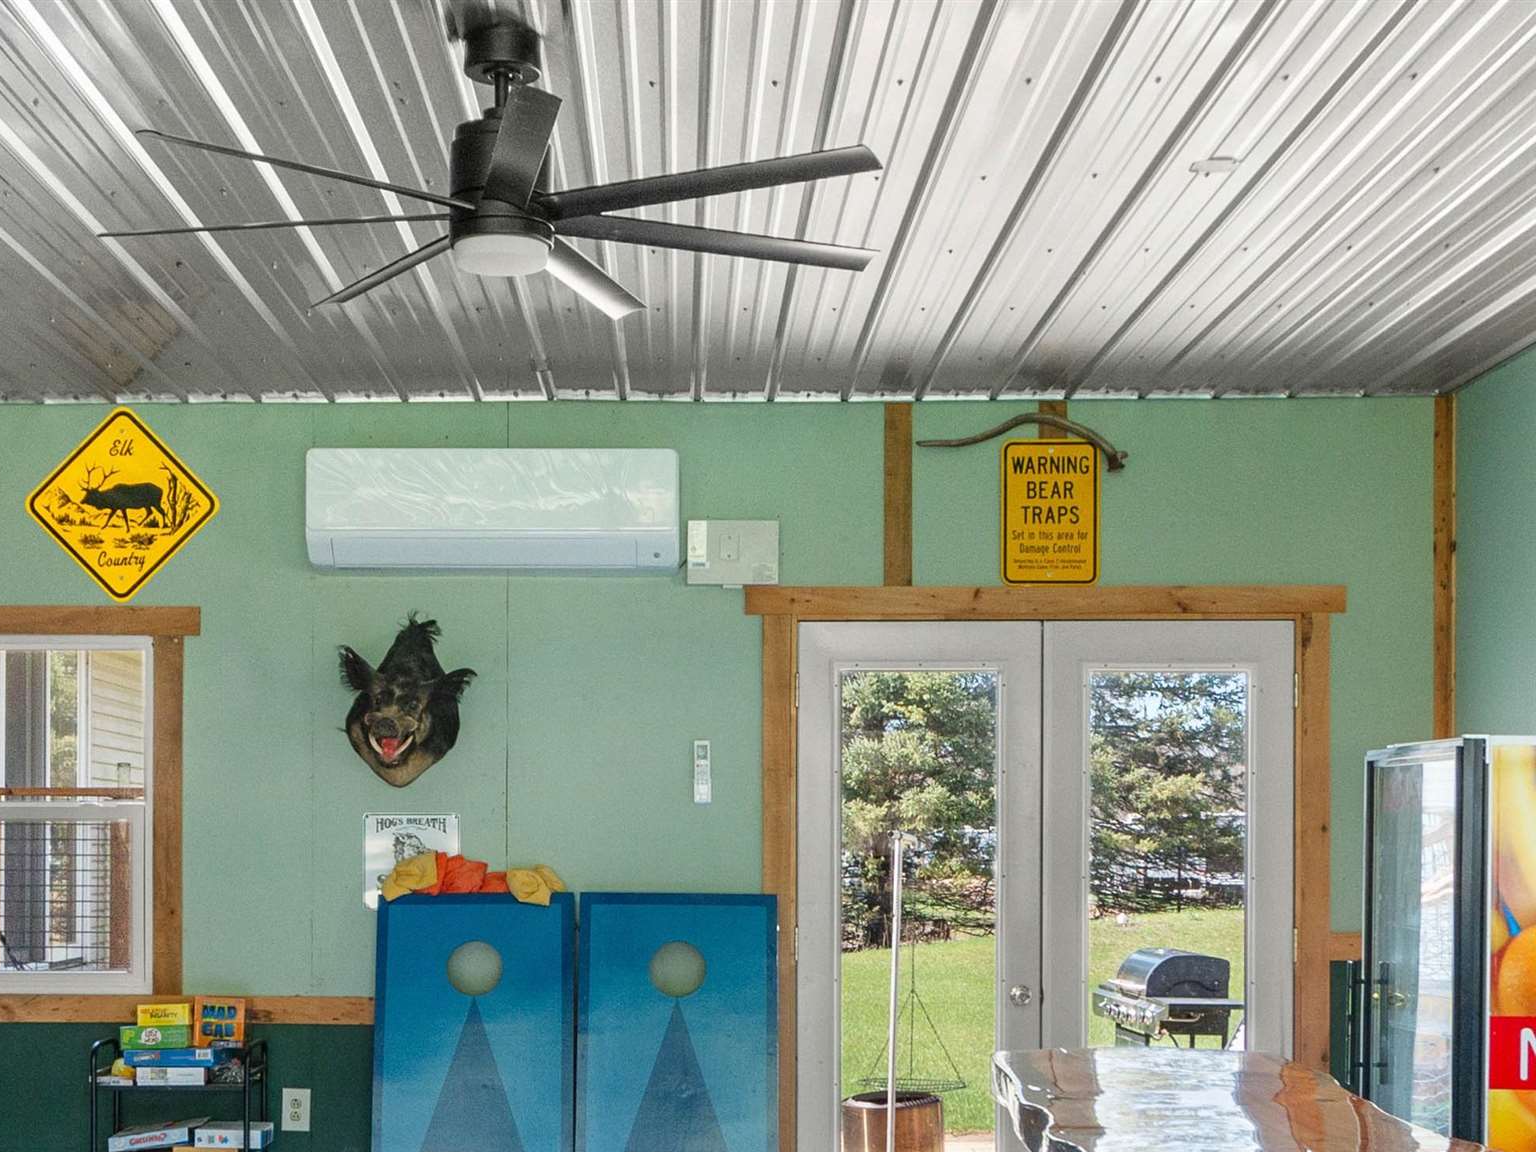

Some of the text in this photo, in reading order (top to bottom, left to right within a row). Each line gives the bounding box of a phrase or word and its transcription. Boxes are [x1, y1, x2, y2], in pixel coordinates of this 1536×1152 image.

[109, 439, 134, 457] Elk
[1011, 456, 1090, 475] WARNING
[1026, 481, 1074, 499] BEAR
[1021, 506, 1080, 525] TRAPS
[1012, 530, 1088, 540] Set in this area for
[1020, 543, 1081, 555] Damage Control
[98, 551, 146, 572] Country
[406, 817, 447, 833] BREATH
[201, 1004, 238, 1021] MAD
